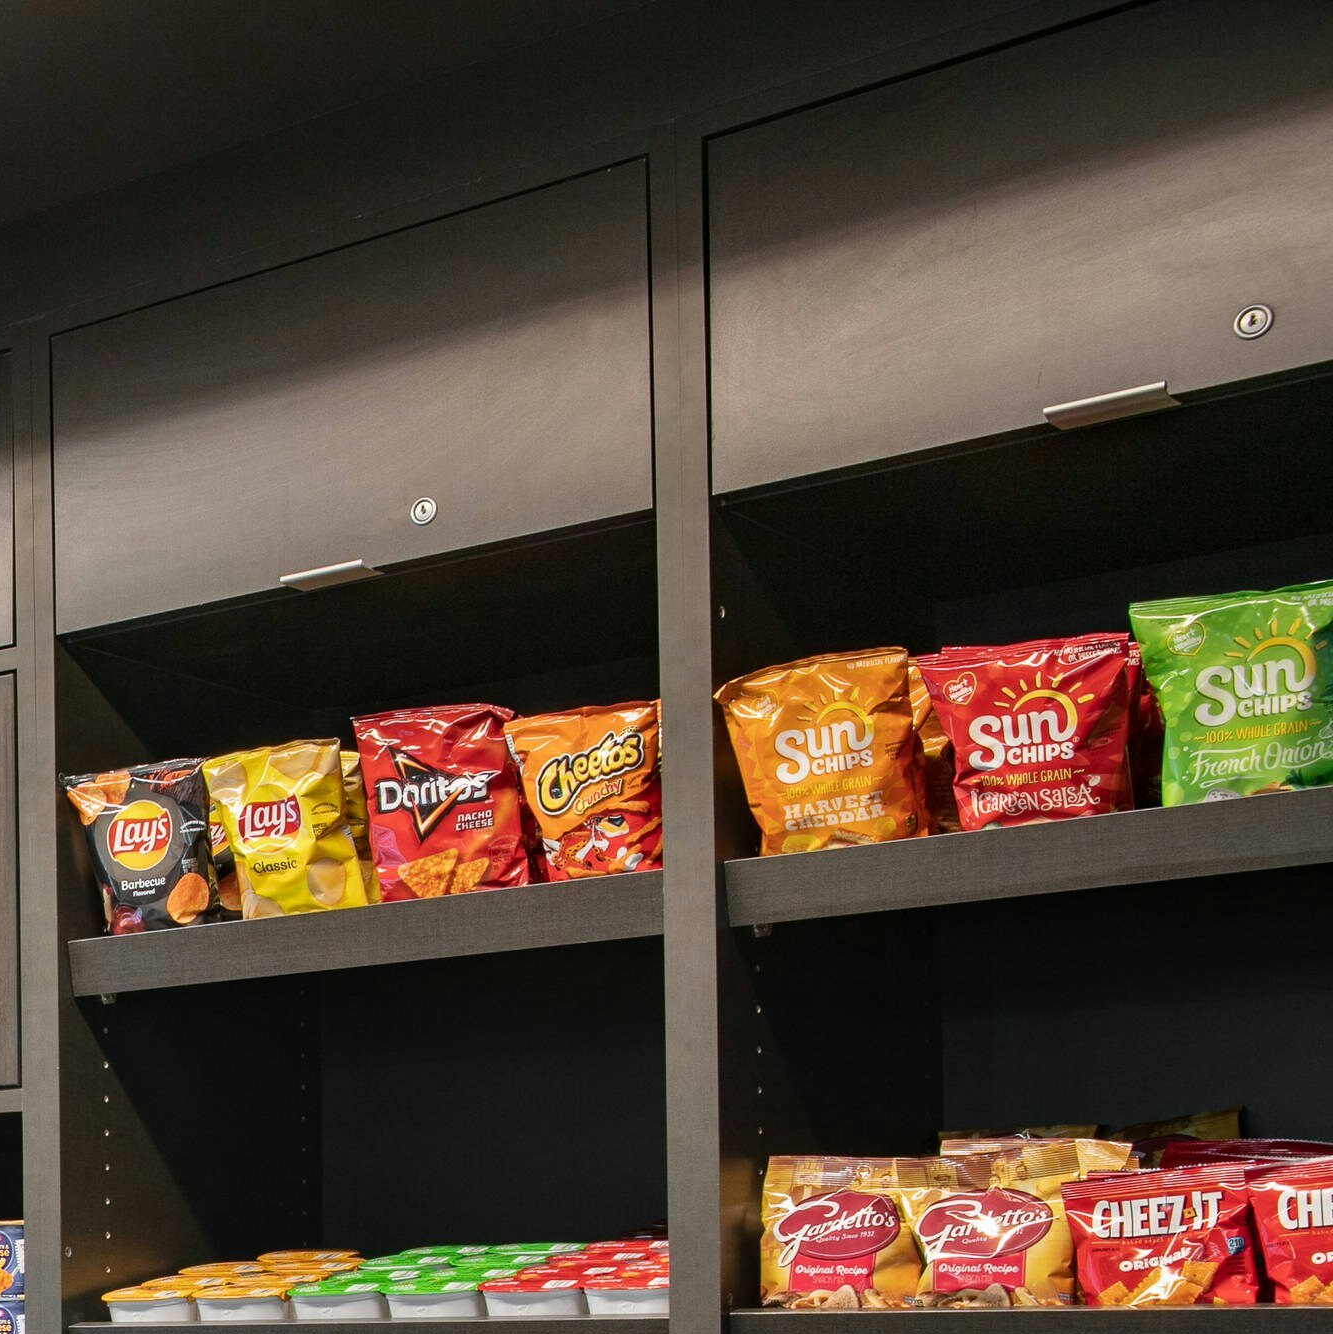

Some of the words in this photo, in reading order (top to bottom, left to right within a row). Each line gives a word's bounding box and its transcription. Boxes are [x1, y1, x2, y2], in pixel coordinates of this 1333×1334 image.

[948, 679, 969, 692] Heart
[1195, 658, 1316, 727] Sun
[1238, 690, 1314, 718] CHIPS
[969, 711, 1077, 771] Sun
[1205, 732, 1234, 744] 100%
[1236, 727, 1273, 740] WHOLE
[1274, 720, 1309, 736] GRAIN
[774, 721, 876, 784] Sun
[810, 749, 875, 776] CHIPS
[1005, 742, 1075, 765] CHIPS
[1190, 744, 1261, 786] French
[1264, 738, 1329, 769] Onion
[539, 733, 641, 813] Cheetos
[843, 775, 872, 790] GRAIN
[981, 775, 1005, 787] 100%
[1005, 772, 1039, 786] WHOLE
[1040, 768, 1072, 783] GRAIN
[377, 774, 490, 812] Doritos
[573, 779, 624, 816] Crunchy
[783, 790, 884, 819] HARVEST
[242, 798, 298, 839] Lay's
[455, 818, 494, 832] CHEESE
[457, 809, 493, 822] NACHO
[785, 804, 885, 832] CHEDDAR
[113, 816, 169, 854] Lay's
[253, 858, 298, 874] Classic
[121, 877, 166, 891] Barbecue
[133, 888, 156, 897] Flavored
[774, 1199, 897, 1267] Gardetto's
[815, 1234, 840, 1243] Quality
[859, 1230, 875, 1238] 1932
[915, 1199, 1048, 1260] Garetto's
[795, 1265, 835, 1276] Original
[835, 1265, 868, 1276] Recipe
[938, 1263, 981, 1274] Original
[983, 1263, 1019, 1274] Recipe
